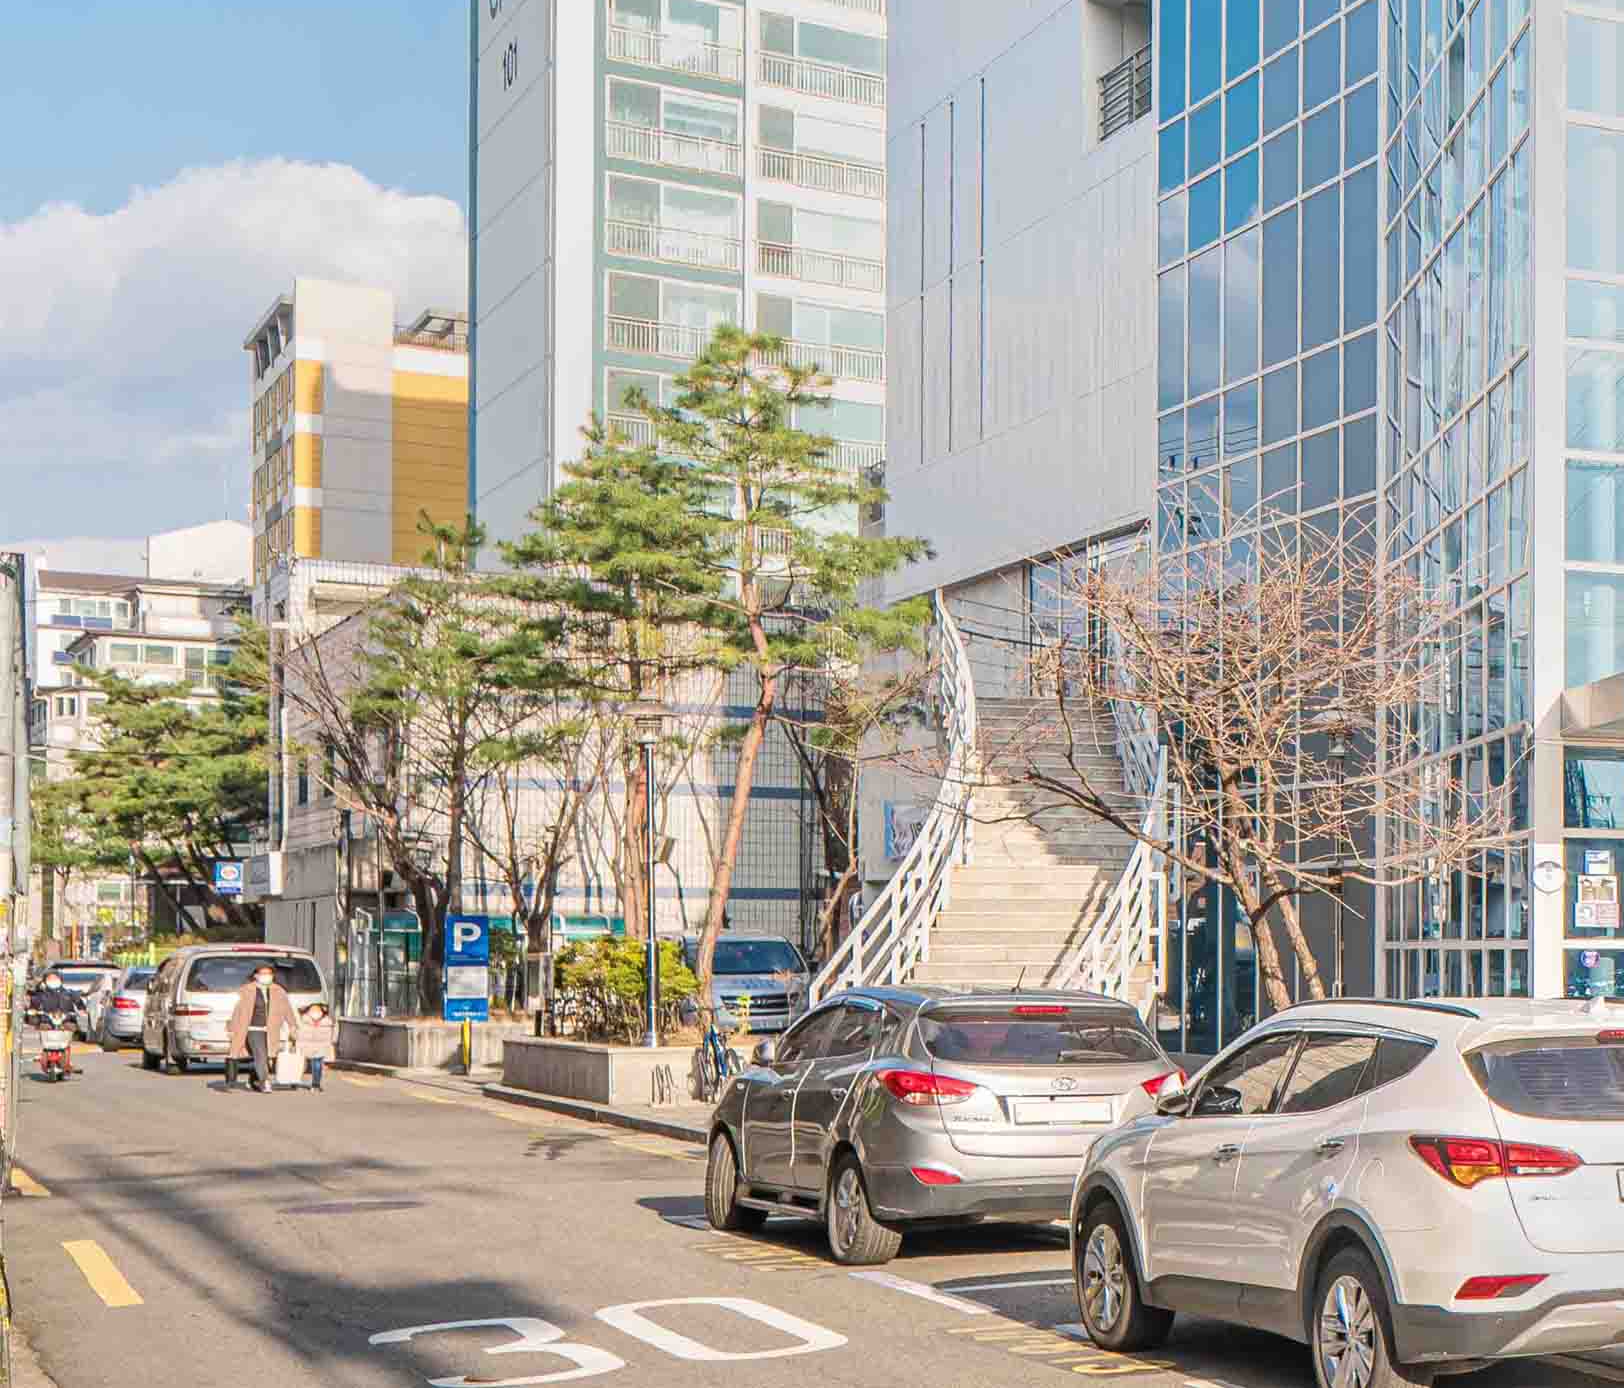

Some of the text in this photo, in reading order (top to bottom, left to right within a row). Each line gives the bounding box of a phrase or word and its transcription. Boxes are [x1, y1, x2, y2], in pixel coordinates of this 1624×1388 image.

[503, 37, 518, 92] 101
[453, 921, 482, 953] P
[368, 1296, 849, 1388] 30
